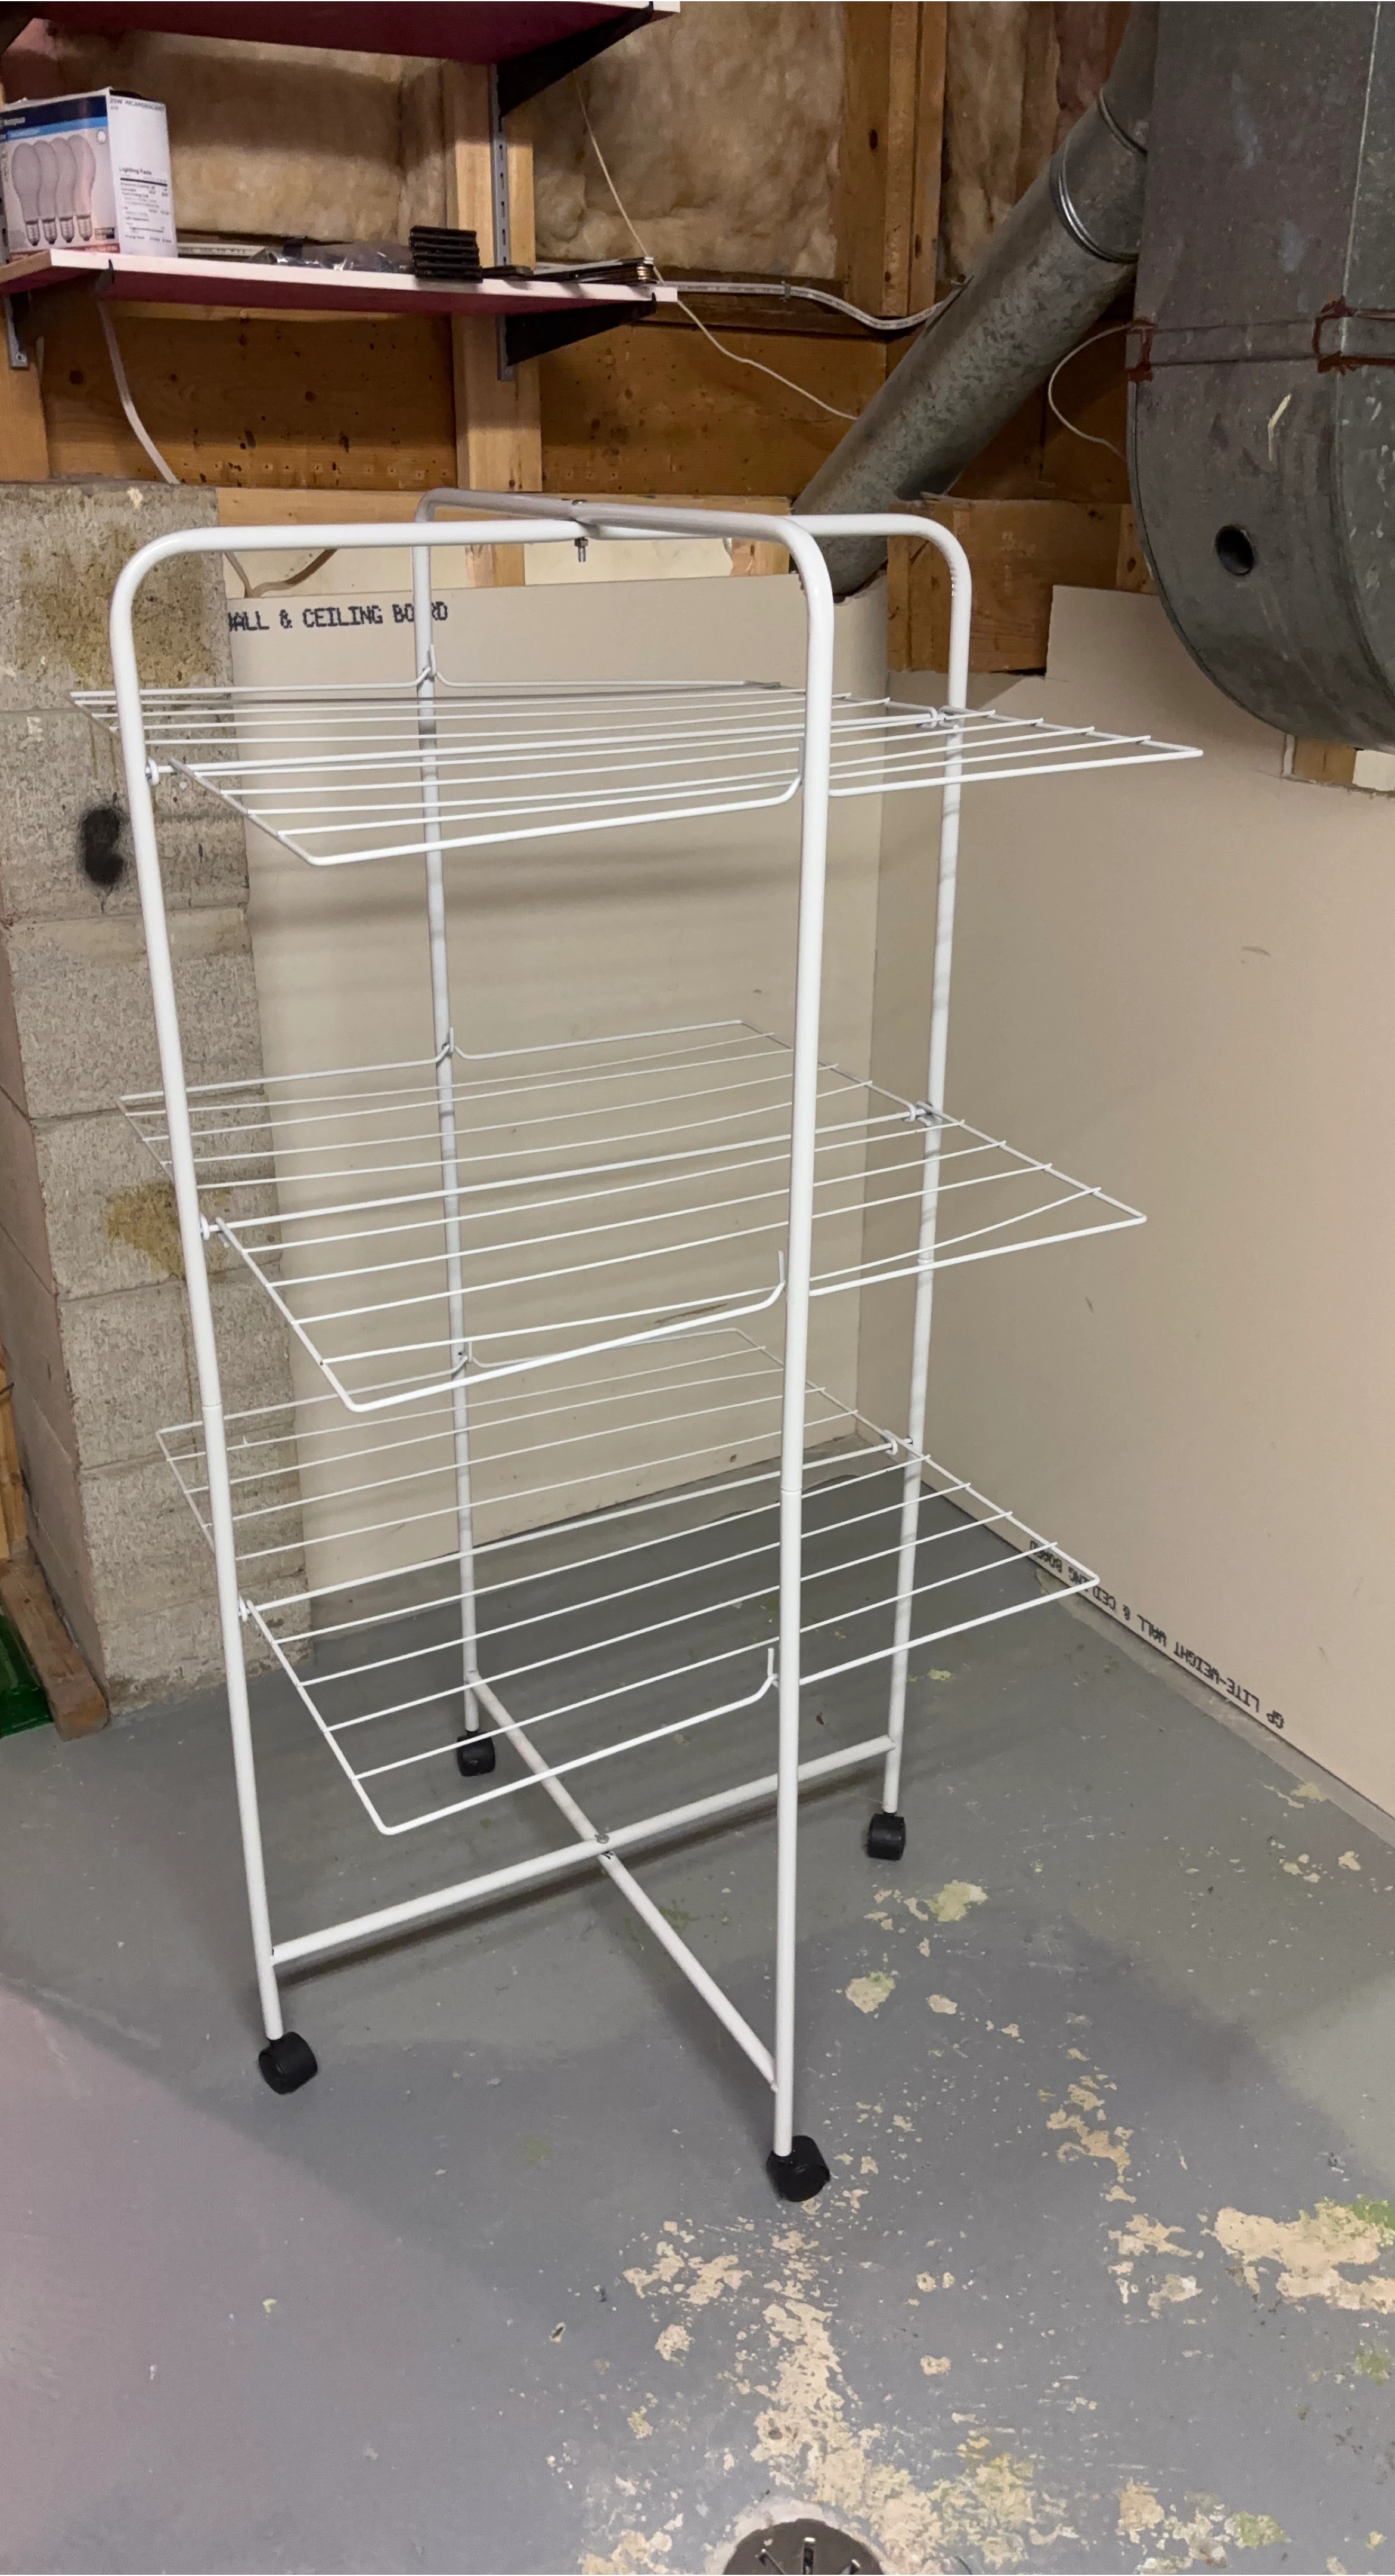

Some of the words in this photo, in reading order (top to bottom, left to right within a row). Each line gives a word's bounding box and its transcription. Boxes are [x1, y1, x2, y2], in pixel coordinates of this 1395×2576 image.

[280, 609, 293, 629] &
[302, 605, 383, 627] CEILING
[392, 601, 448, 623] BORD
[1122, 1604, 1131, 1621] &
[1136, 1614, 1167, 1648] WALL
[1173, 1641, 1260, 1713] LITE-WEIGHT
[1266, 1710, 1284, 1729] GP
